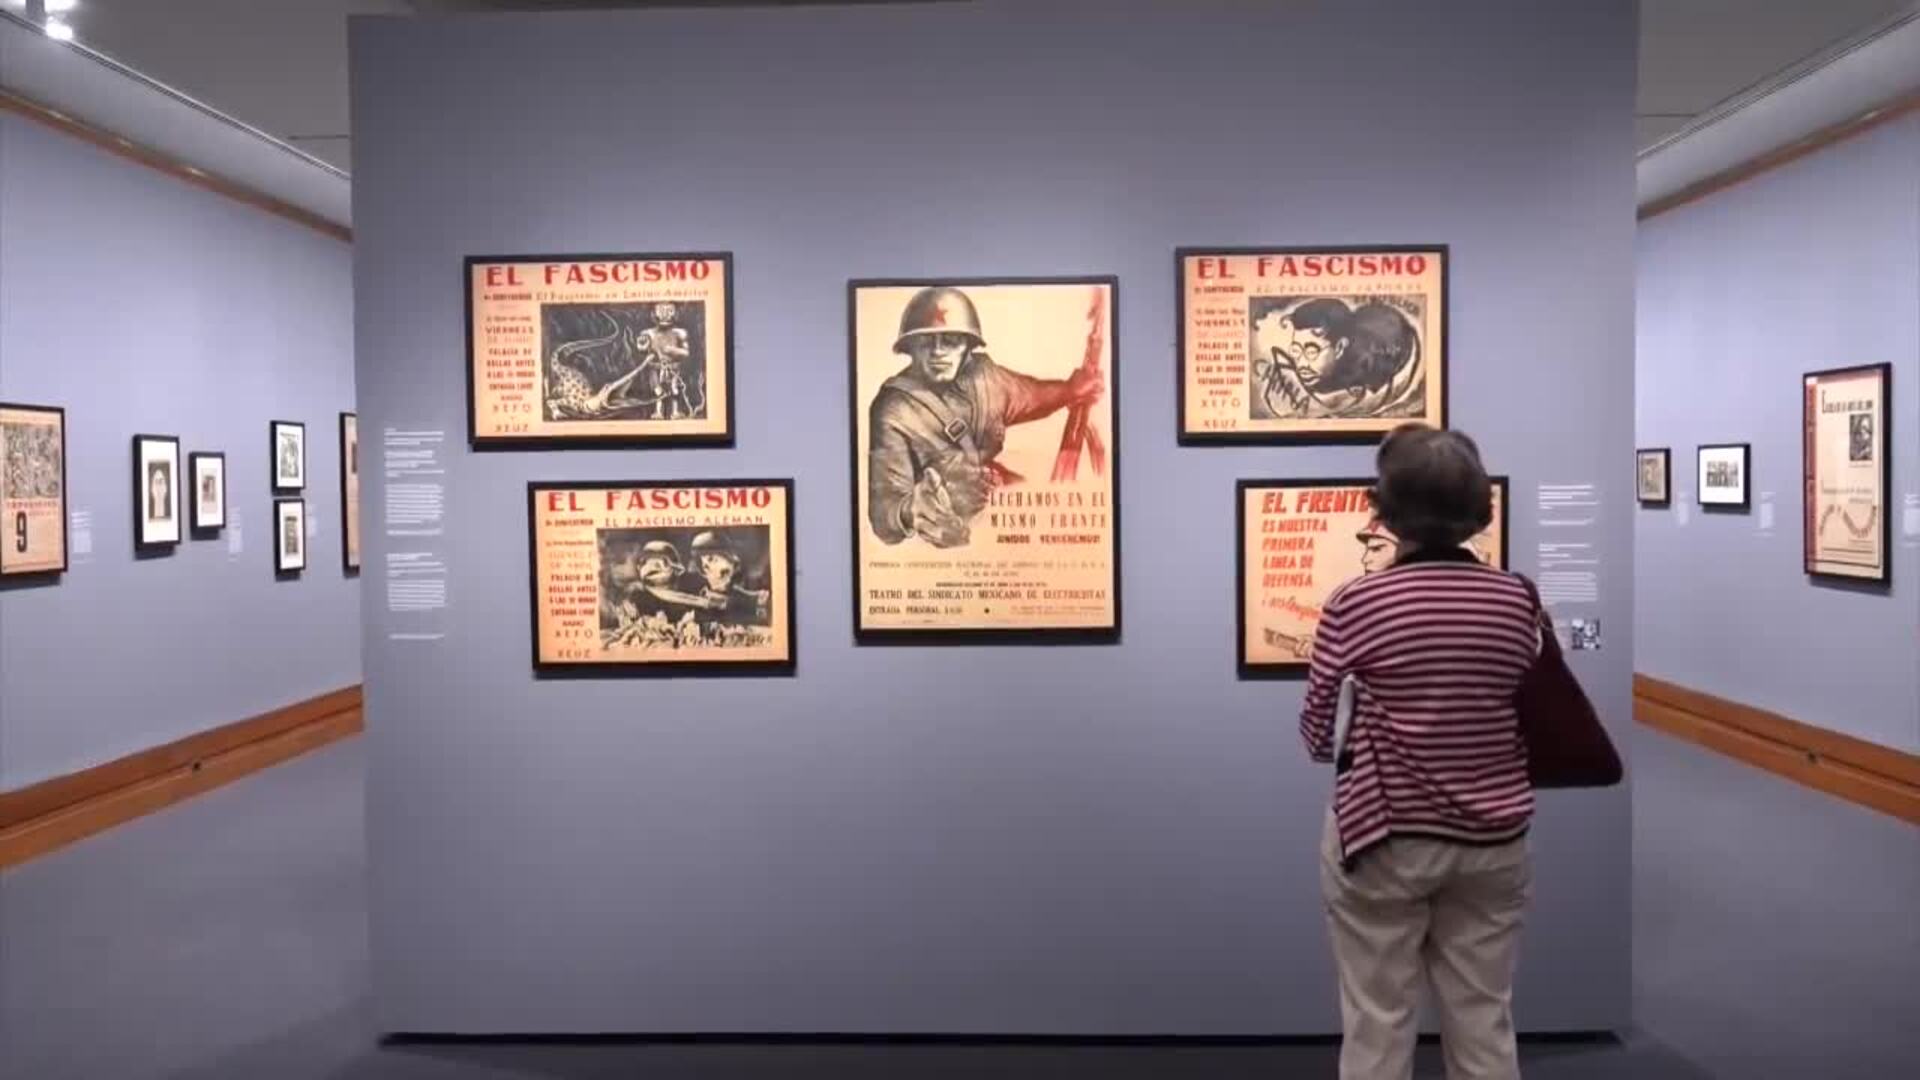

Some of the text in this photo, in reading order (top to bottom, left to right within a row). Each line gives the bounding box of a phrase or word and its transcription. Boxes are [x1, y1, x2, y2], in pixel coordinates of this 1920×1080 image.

[486, 261, 710, 287] EL FASCISMO
[1198, 256, 1426, 279] EL FASCISMO
[548, 488, 771, 512] EL FASCISMO
[1068, 492, 1083, 507] EN
[1091, 492, 1106, 507] EL
[1262, 489, 1369, 514] EL FRENTE
[627, 516, 696, 526] FASCISMO
[704, 515, 763, 525] ALEMAN
[990, 513, 1106, 529] MISMO FRENTE
[1262, 520, 1275, 533] ES
[16, 511, 27, 553] 9
[1262, 538, 1315, 551] PRIMERA
[869, 589, 902, 599] TEATRO
[907, 590, 925, 599] DEL
[927, 589, 973, 599] SINDICATO
[978, 589, 1022, 599] MEXICANO
